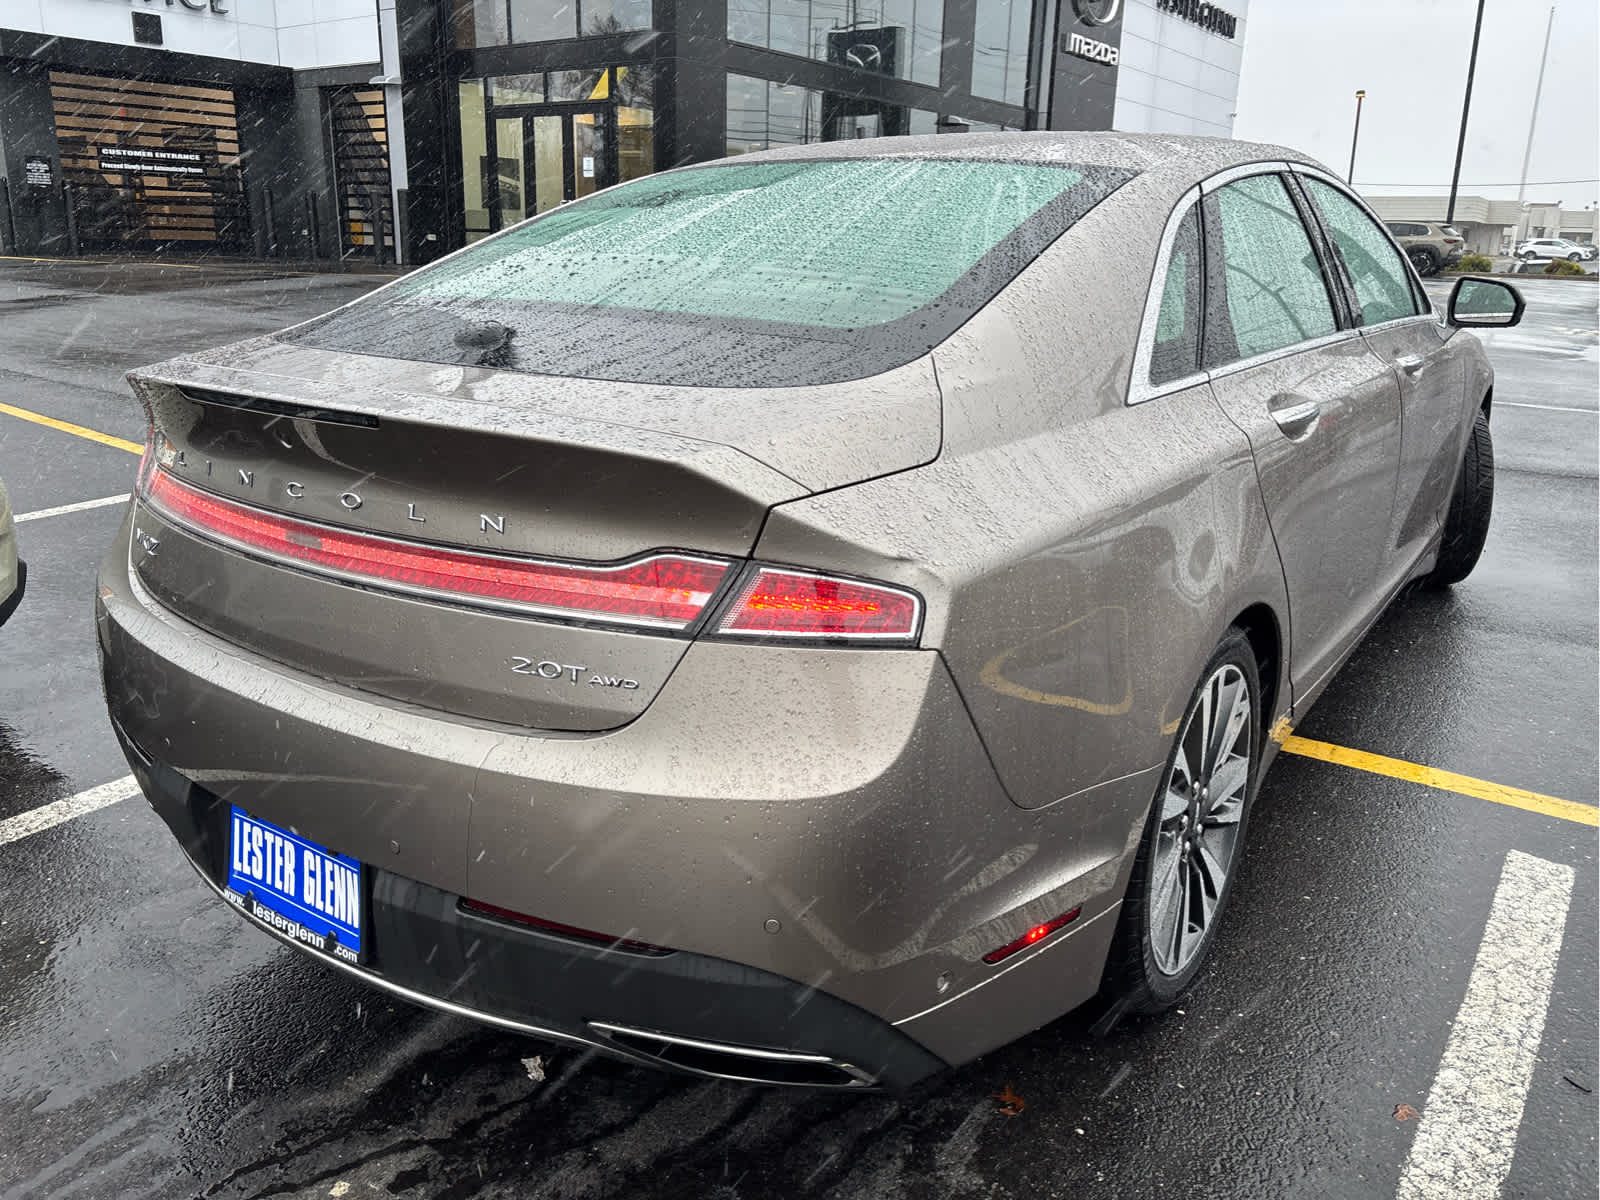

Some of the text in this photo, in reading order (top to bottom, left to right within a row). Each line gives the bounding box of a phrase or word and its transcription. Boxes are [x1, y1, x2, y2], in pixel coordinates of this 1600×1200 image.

[1070, 33, 1120, 66] mazda
[101, 148, 201, 161] CUSTOMER ENTRANCE
[175, 451, 505, 534] LINCOLN
[589, 674, 640, 689] AWD
[233, 817, 360, 929] LESTER GLENN
